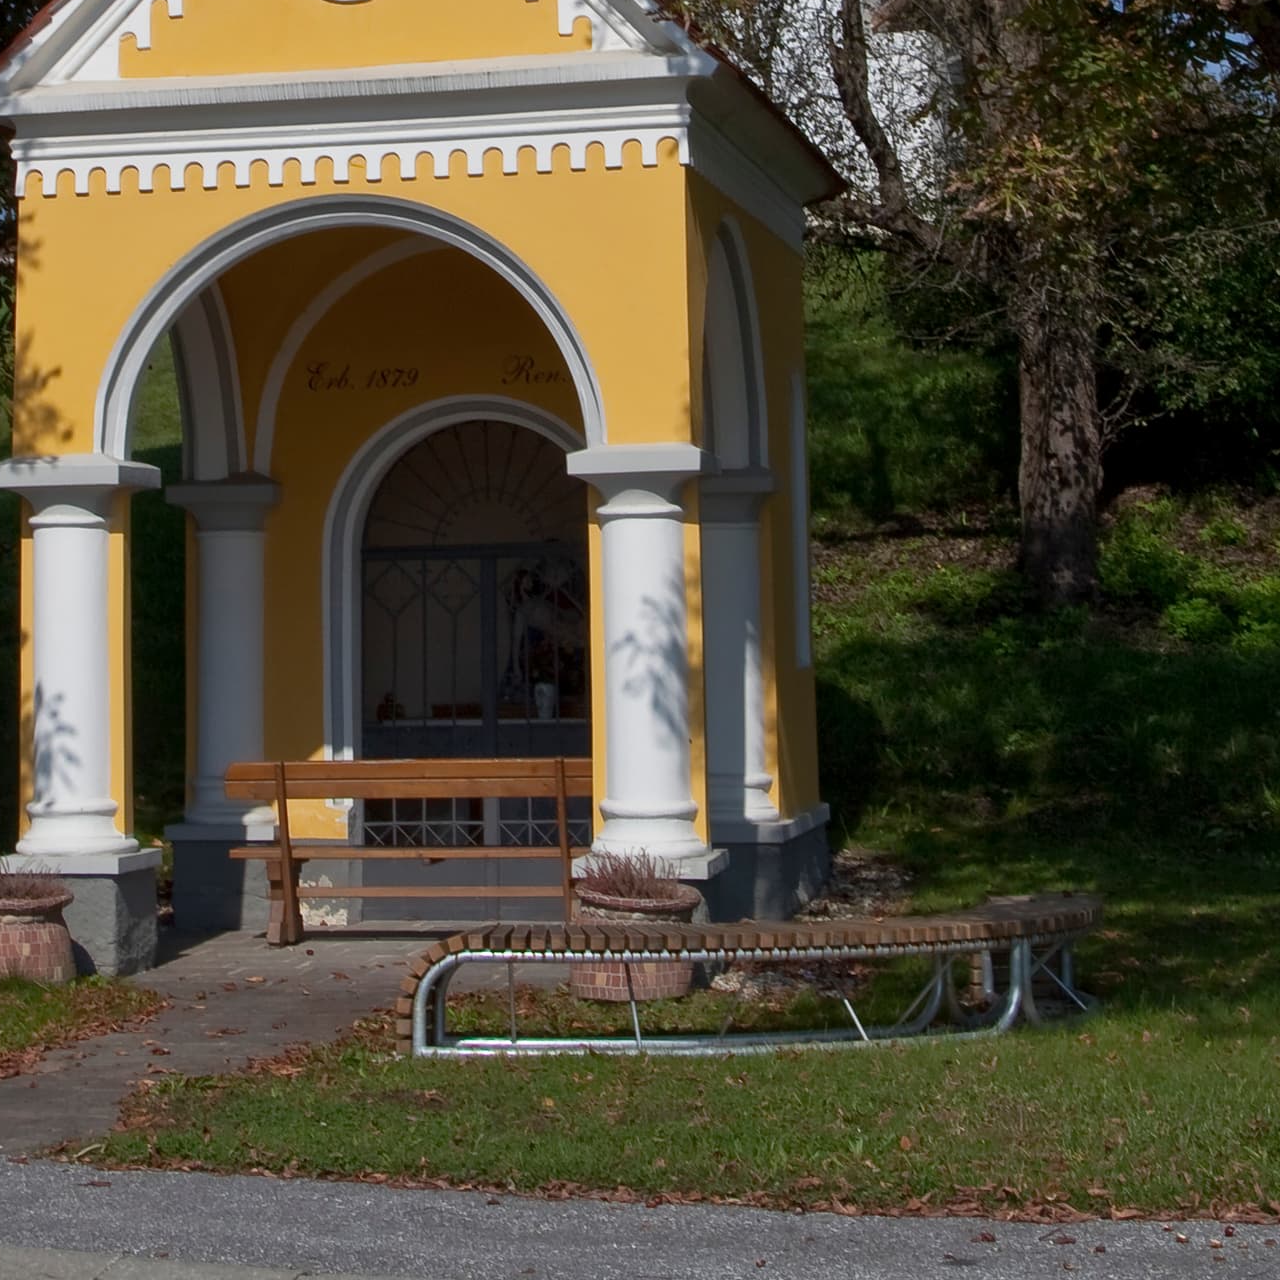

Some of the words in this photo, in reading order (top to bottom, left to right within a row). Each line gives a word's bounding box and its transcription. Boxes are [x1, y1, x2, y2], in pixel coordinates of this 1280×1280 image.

[306, 360, 355, 391] Erb.
[365, 367, 420, 389] 1879
[501, 354, 567, 386] Ren.
